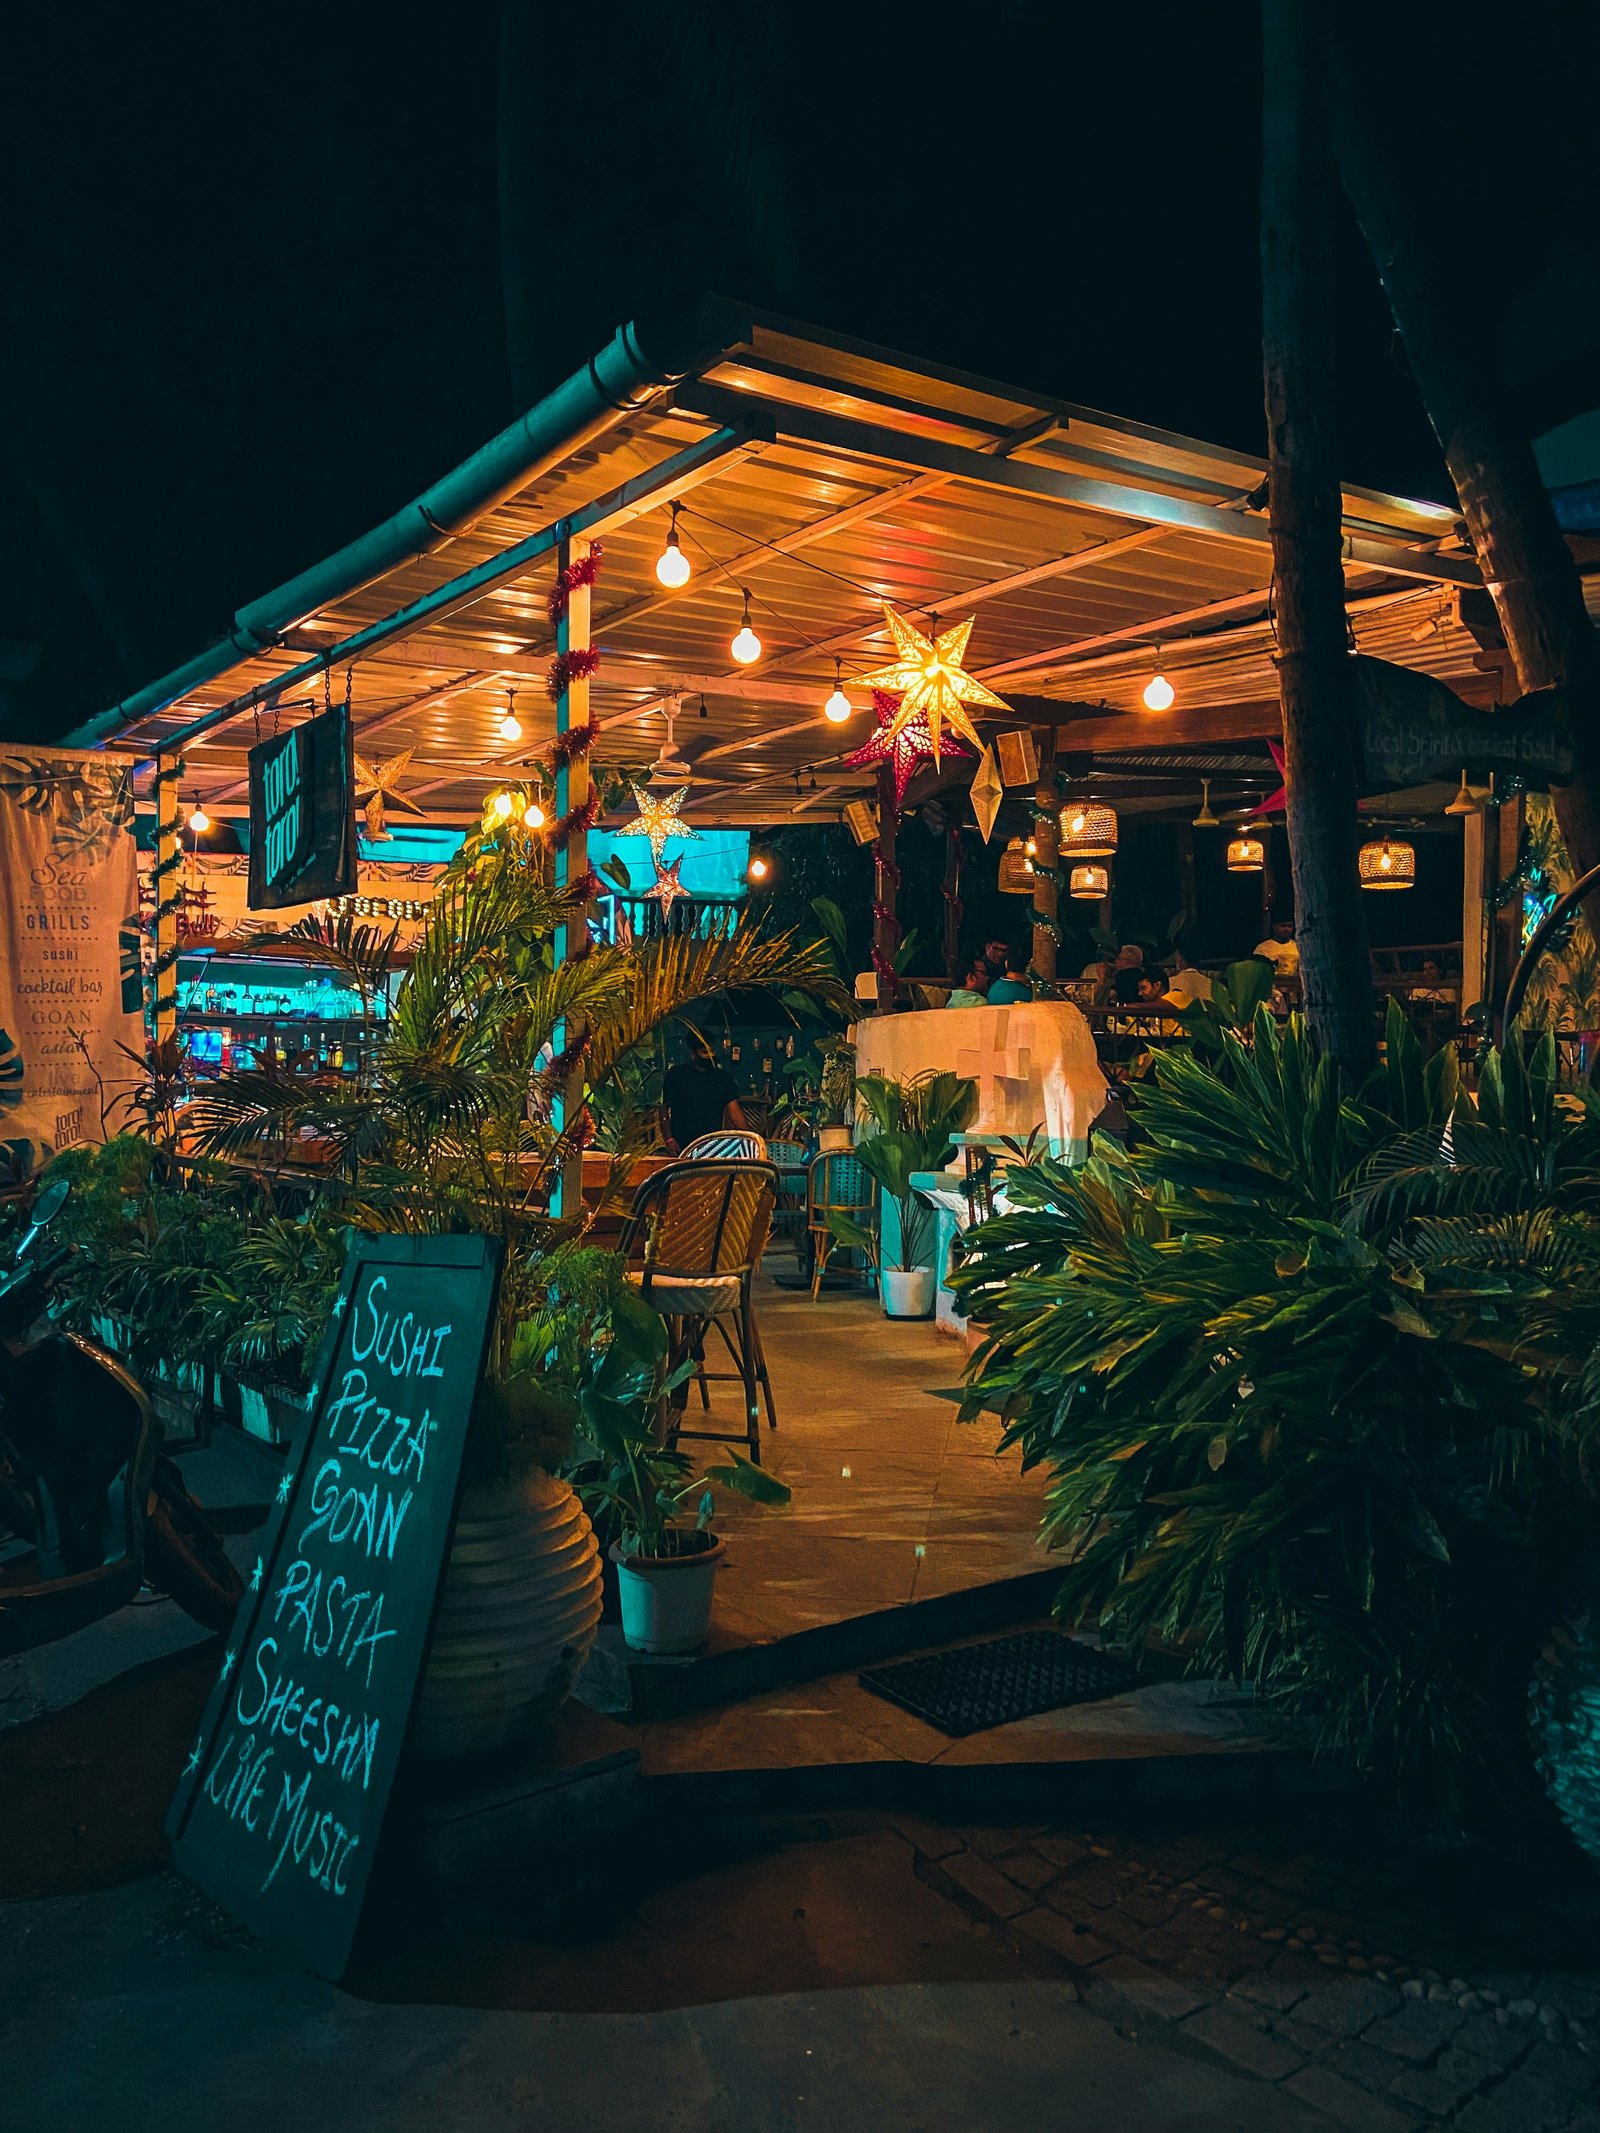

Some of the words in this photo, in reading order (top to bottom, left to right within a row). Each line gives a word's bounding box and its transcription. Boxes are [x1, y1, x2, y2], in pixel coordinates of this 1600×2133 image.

[30, 852, 88, 886] Sea
[30, 885, 87, 901] FOOD
[26, 913, 91, 931] GRILLS
[42, 947, 79, 961] sushi
[17, 976, 76, 995] cocktail
[79, 976, 103, 996] bar
[31, 1009, 92, 1025] GOAN
[55, 1106, 84, 1132] toro!
[54, 1124, 82, 1150] toro!
[326, 1368, 431, 1483] PIZZA
[274, 1560, 398, 1689] PASTA
